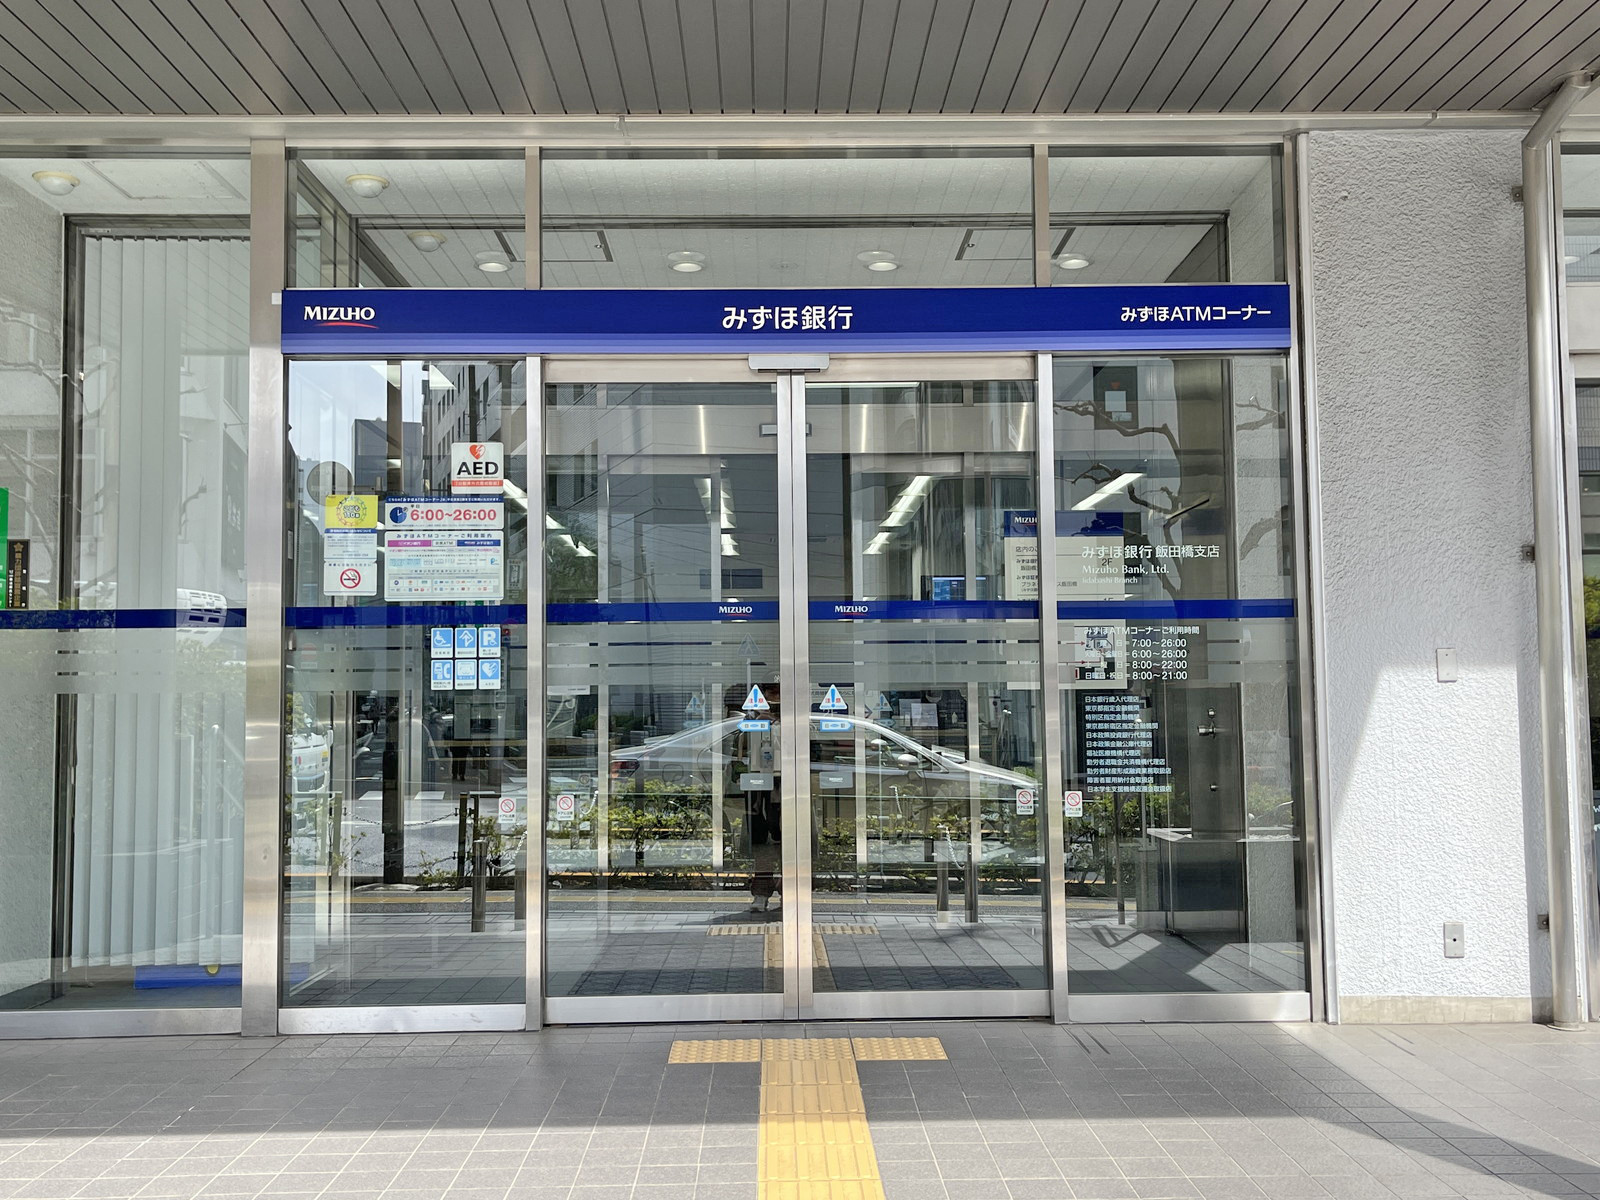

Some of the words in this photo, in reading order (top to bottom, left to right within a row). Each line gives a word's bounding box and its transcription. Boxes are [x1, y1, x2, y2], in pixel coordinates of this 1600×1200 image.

[304, 306, 376, 320] MIZUHO
[722, 306, 853, 330] みずほ銀行
[1120, 304, 1272, 322] みずほATMコーナー
[456, 462, 499, 475] AED
[1082, 545, 1152, 558] みずほ銀行
[1156, 545, 1219, 558] 飯田橋支店
[1082, 565, 1118, 574] Mizuho
[1122, 565, 1148, 575] Bank,
[1151, 565, 1169, 574] Ltd.
